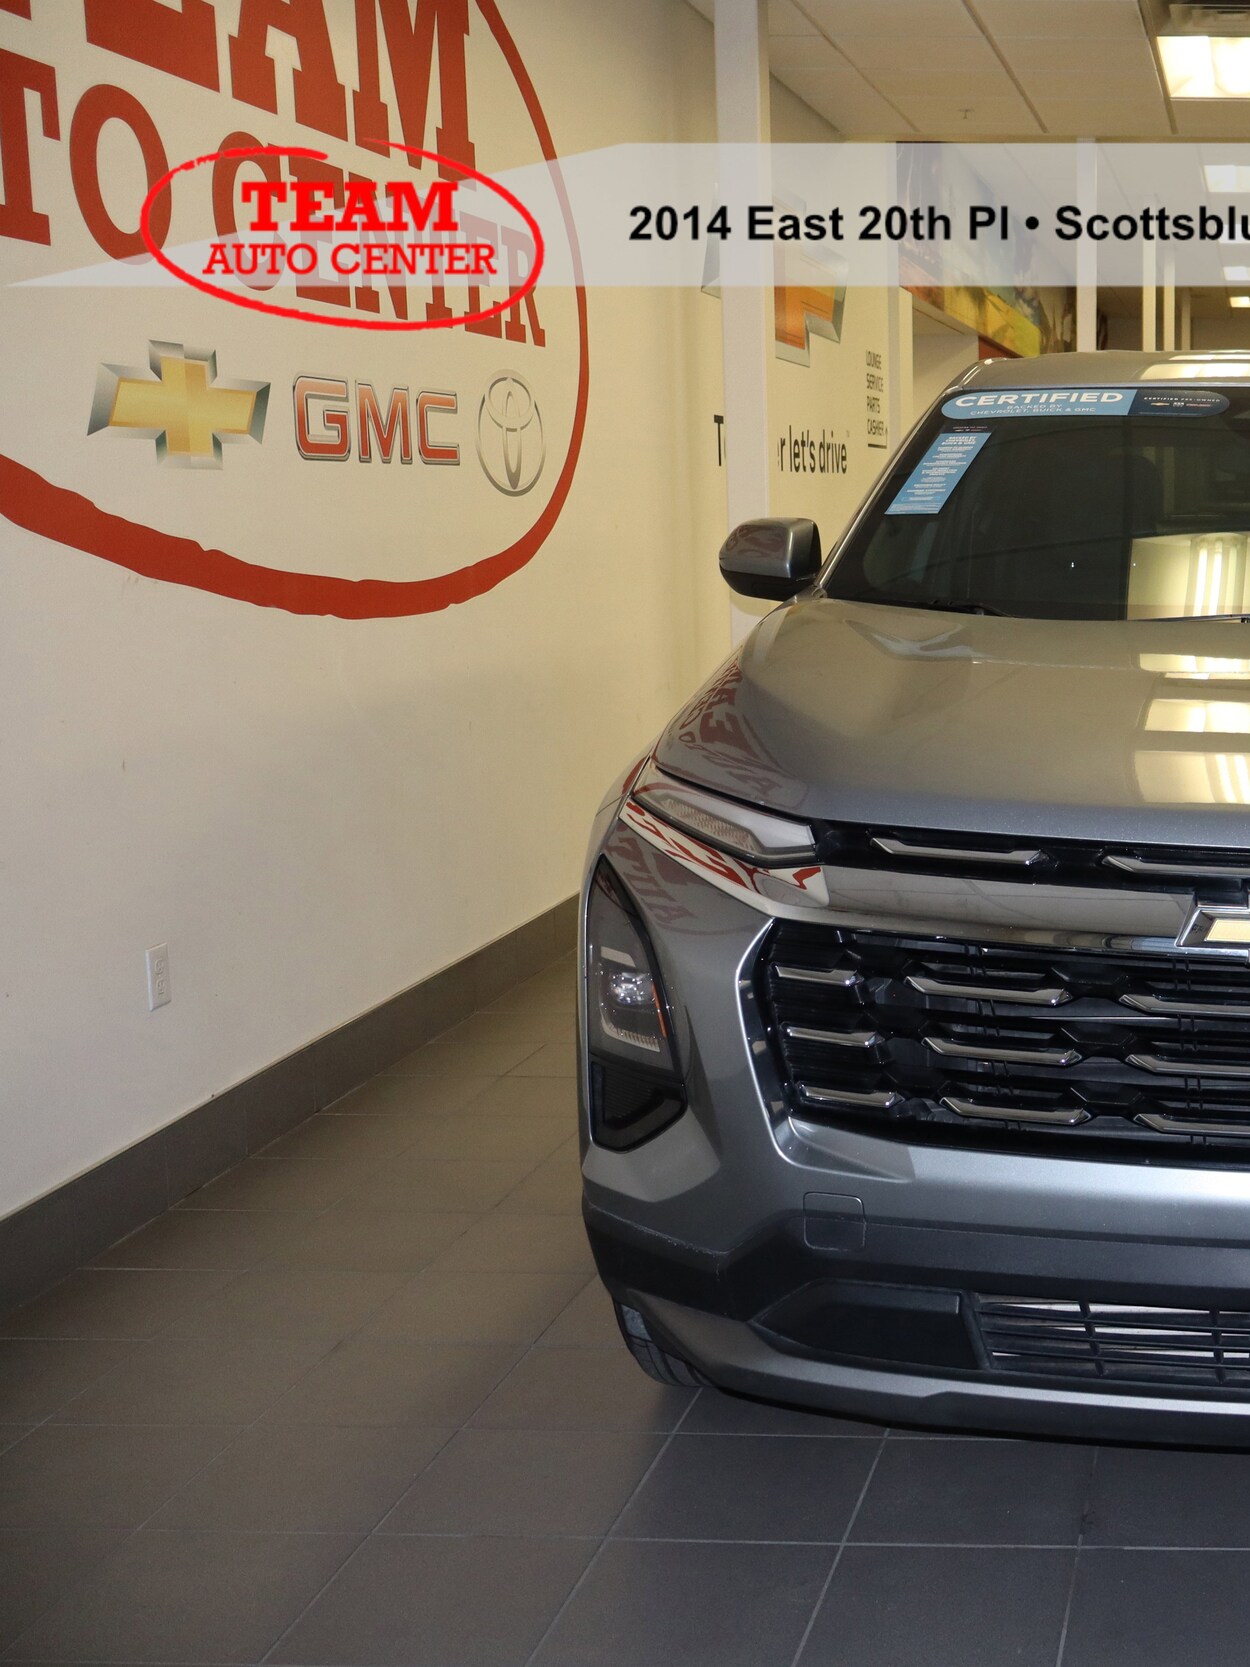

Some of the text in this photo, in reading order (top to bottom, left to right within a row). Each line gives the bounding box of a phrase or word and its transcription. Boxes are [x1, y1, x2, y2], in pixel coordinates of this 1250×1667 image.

[866, 350, 882, 370] LOUNGE
[866, 373, 883, 393] SERVICE
[867, 395, 881, 414] PARTS
[955, 392, 1124, 407] CERTIFIED
[293, 373, 460, 465] GMC
[789, 425, 816, 474] let's
[819, 429, 847, 475] drive
